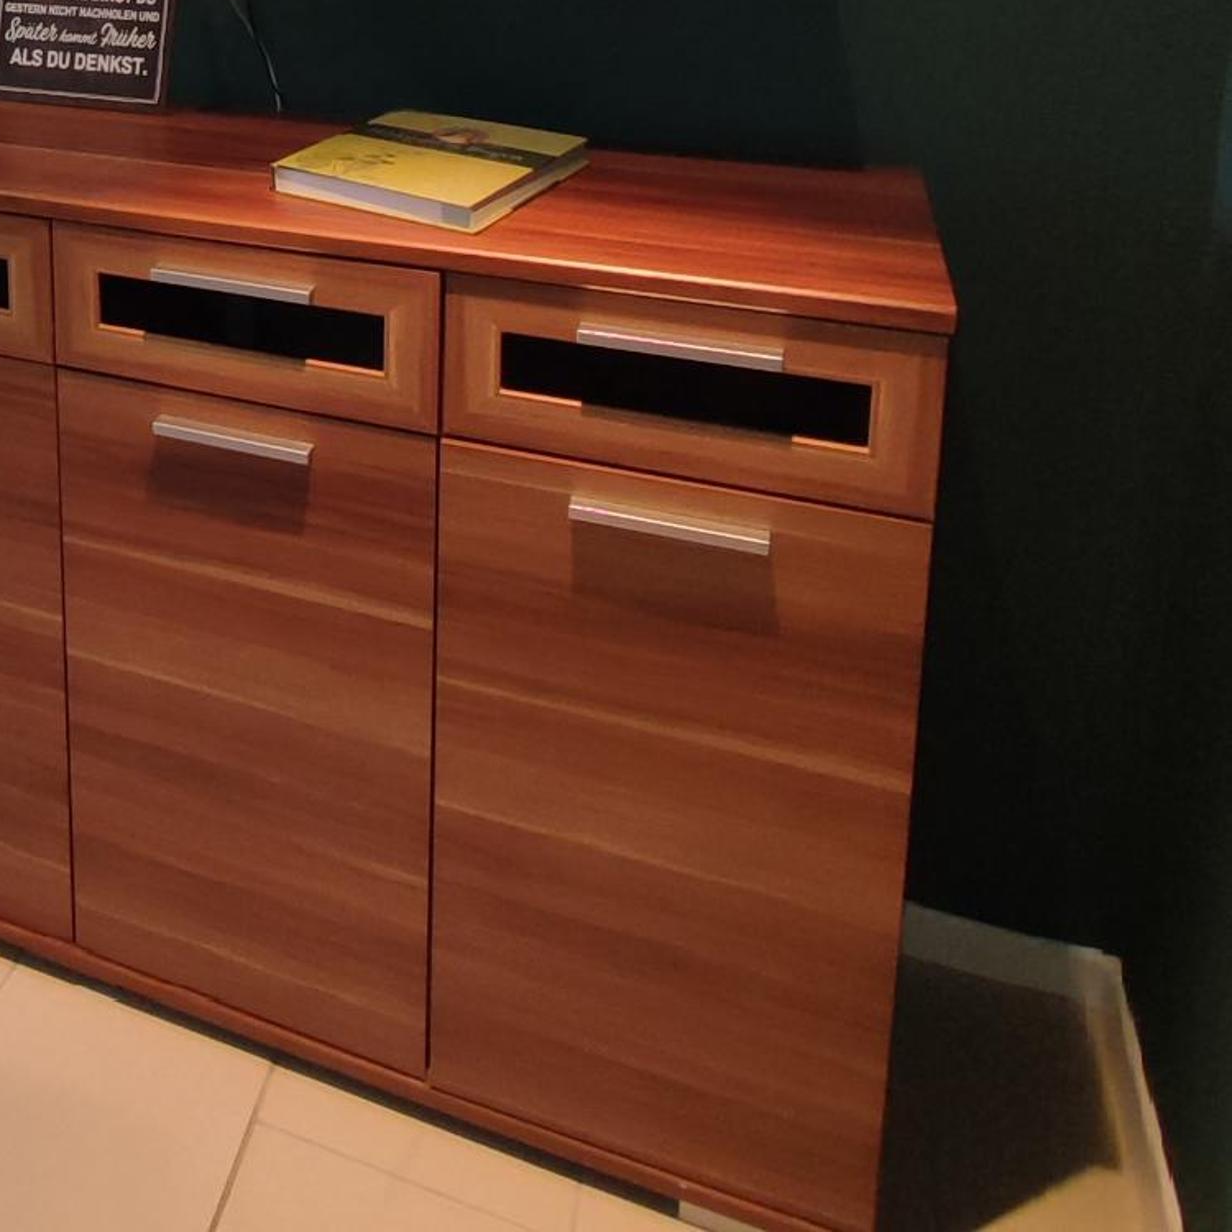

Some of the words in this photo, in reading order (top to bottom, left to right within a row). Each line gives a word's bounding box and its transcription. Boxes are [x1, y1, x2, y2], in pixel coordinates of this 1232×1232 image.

[5, 2, 47, 15] GESTERN
[48, 5, 78, 17] NICHT
[79, 6, 137, 20] NACHHOLEN
[139, 10, 160, 22] UND
[4, 17, 58, 43] Später
[59, 30, 97, 46] kommt
[100, 22, 157, 50] Früher
[10, 48, 43, 66] ALS
[47, 51, 71, 69] DU
[74, 53, 148, 75] DENKST.
